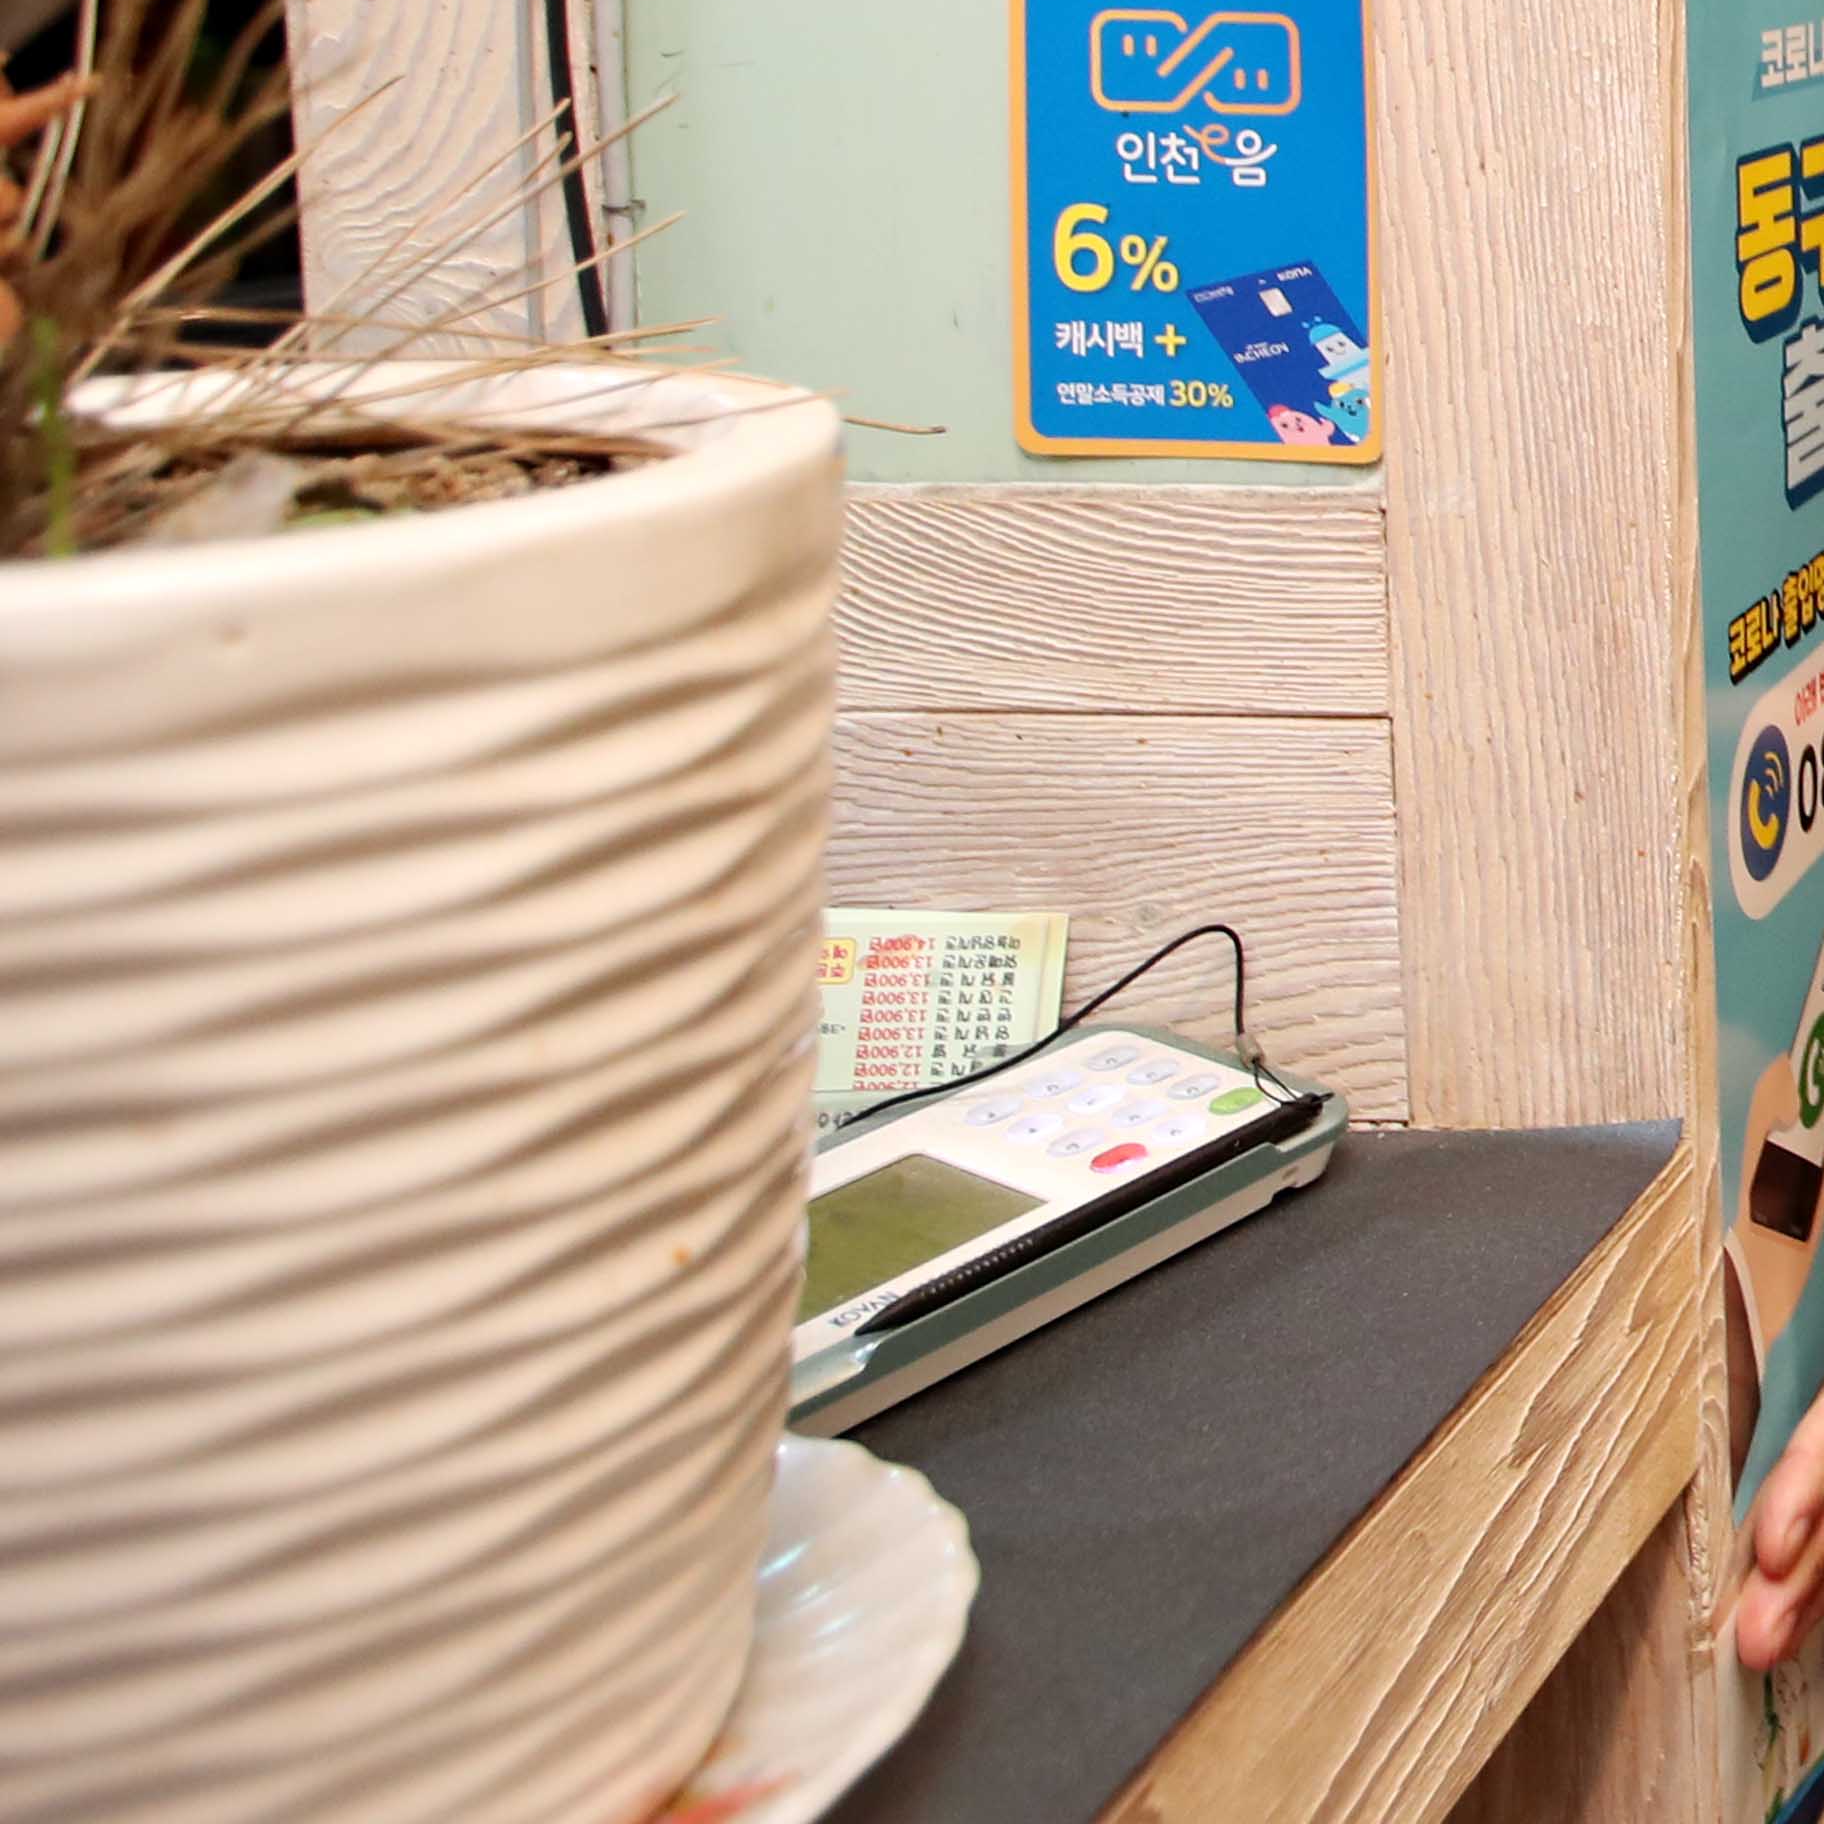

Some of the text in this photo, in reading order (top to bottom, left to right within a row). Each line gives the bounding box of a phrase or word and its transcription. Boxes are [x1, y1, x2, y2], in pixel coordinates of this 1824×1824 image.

[1116, 124, 1278, 186] 인천e음
[1053, 202, 1179, 293] 6%
[1055, 321, 1143, 358] 캐시백
[1057, 380, 1234, 409] 연말소득공제 30%
[1728, 590, 1781, 684] 코로나
